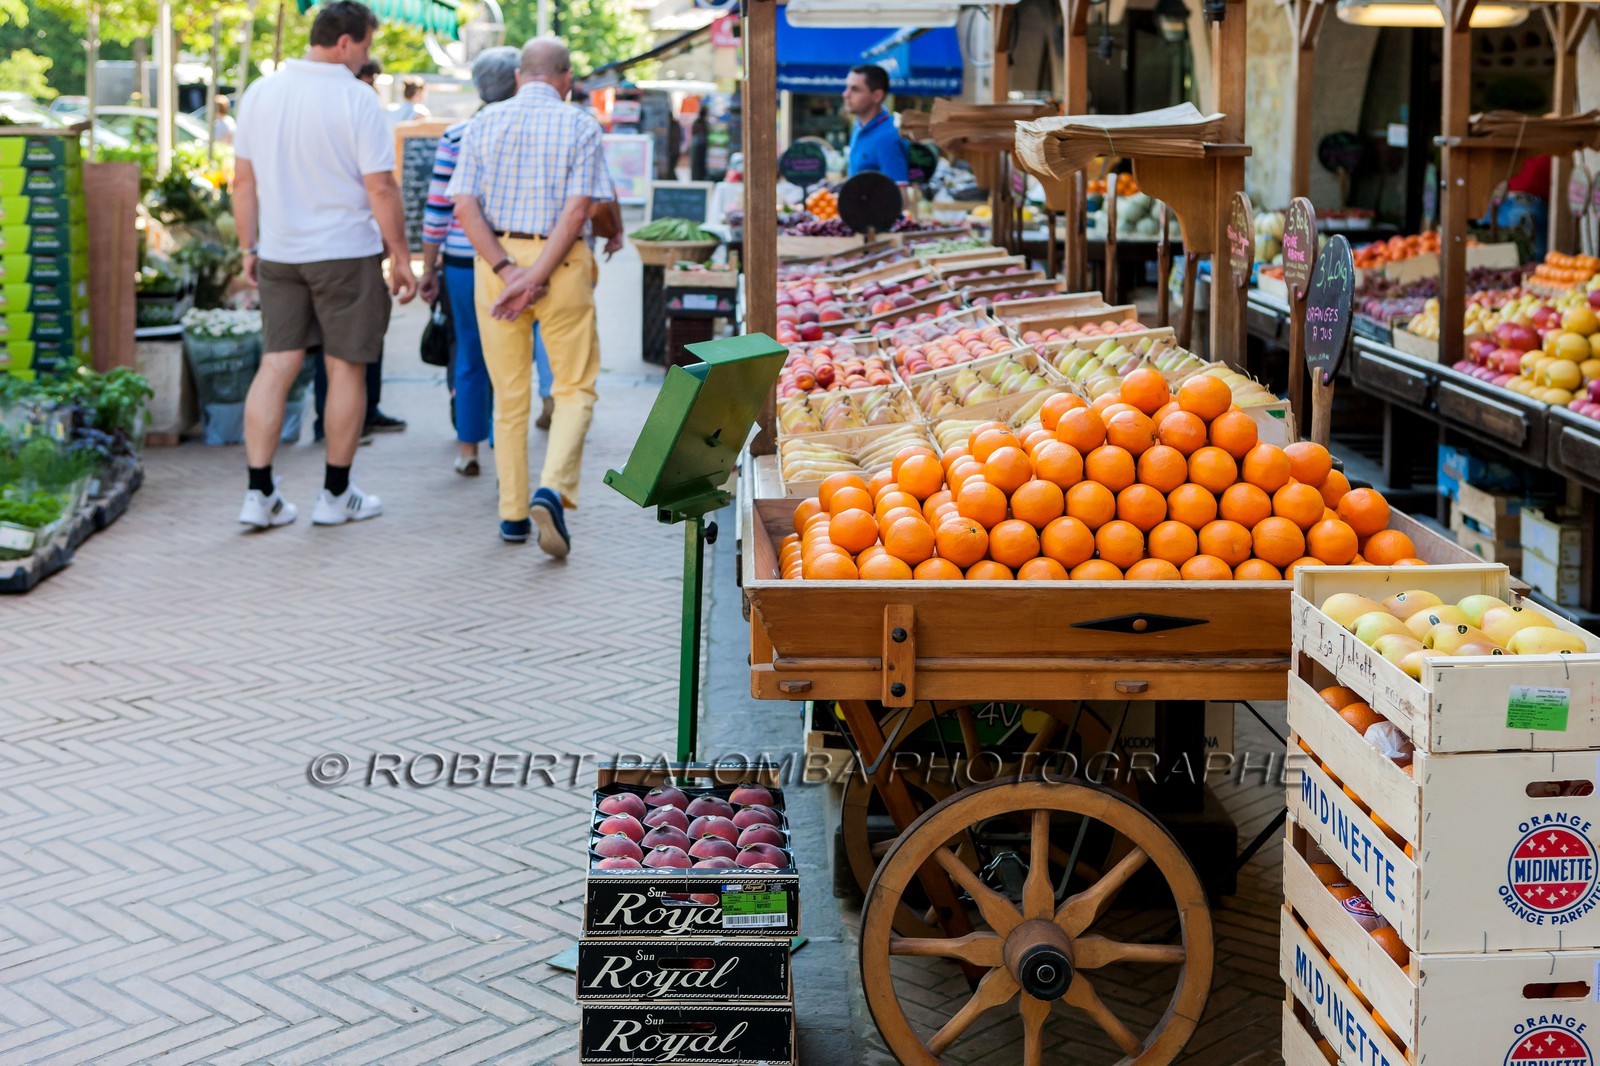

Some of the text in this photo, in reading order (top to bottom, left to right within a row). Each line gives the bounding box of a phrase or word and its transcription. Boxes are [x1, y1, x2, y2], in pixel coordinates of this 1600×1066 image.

[1306, 306, 1339, 323] ORANGES
[1320, 327, 1333, 341] JUS
[1518, 812, 1592, 833] ORANGE
[1301, 769, 1396, 903] MIDINETTE
[1514, 858, 1593, 883] MIDINETTE
[595, 892, 723, 935] Roya
[1498, 885, 1545, 926] ORANGE
[635, 949, 655, 961] Sun
[582, 955, 740, 998] Royal
[645, 1013, 665, 1026] Sun
[1513, 1013, 1588, 1035] ORANGE
[591, 1019, 749, 1062] Royal
